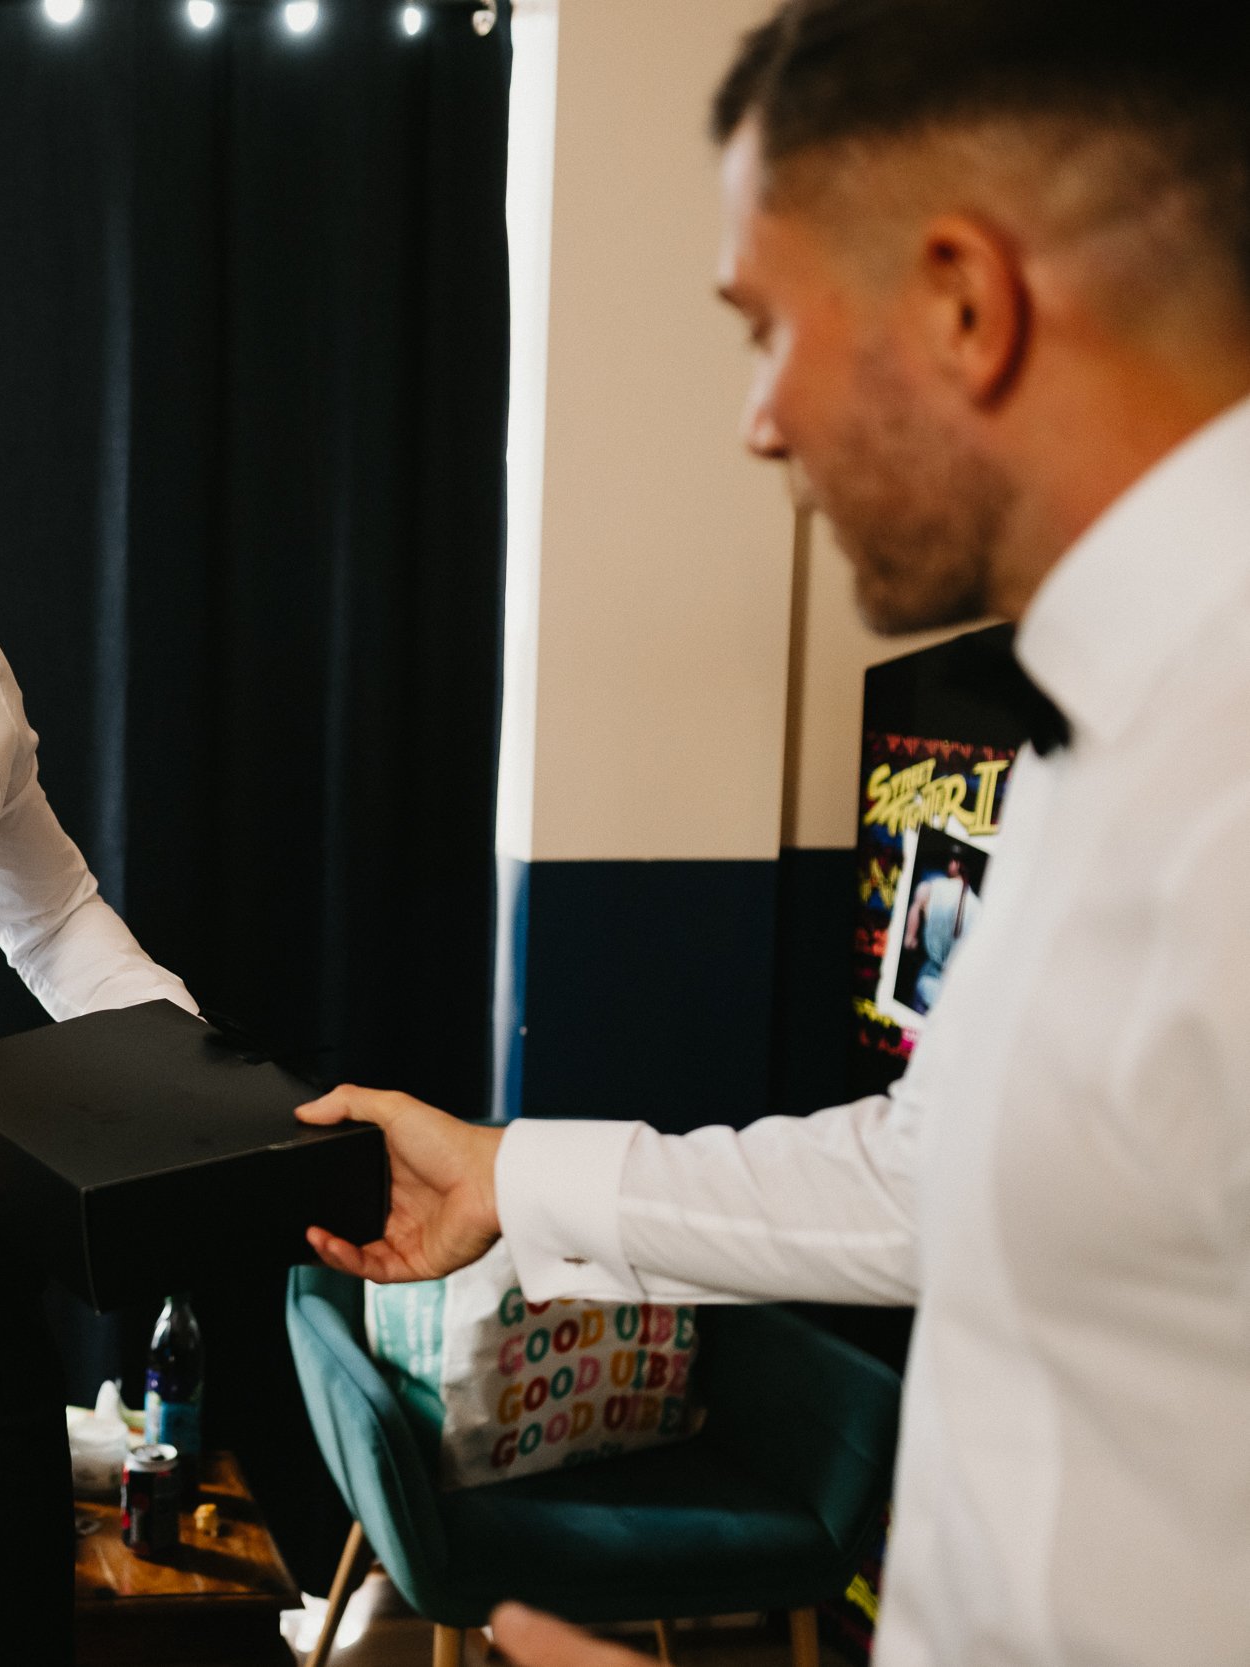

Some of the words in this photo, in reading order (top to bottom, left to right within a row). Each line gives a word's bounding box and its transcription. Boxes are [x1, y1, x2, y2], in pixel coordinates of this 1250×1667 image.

[499, 1309, 603, 1377] GOOD
[498, 1356, 600, 1425] GOOD
[491, 1401, 593, 1468] GOOD
